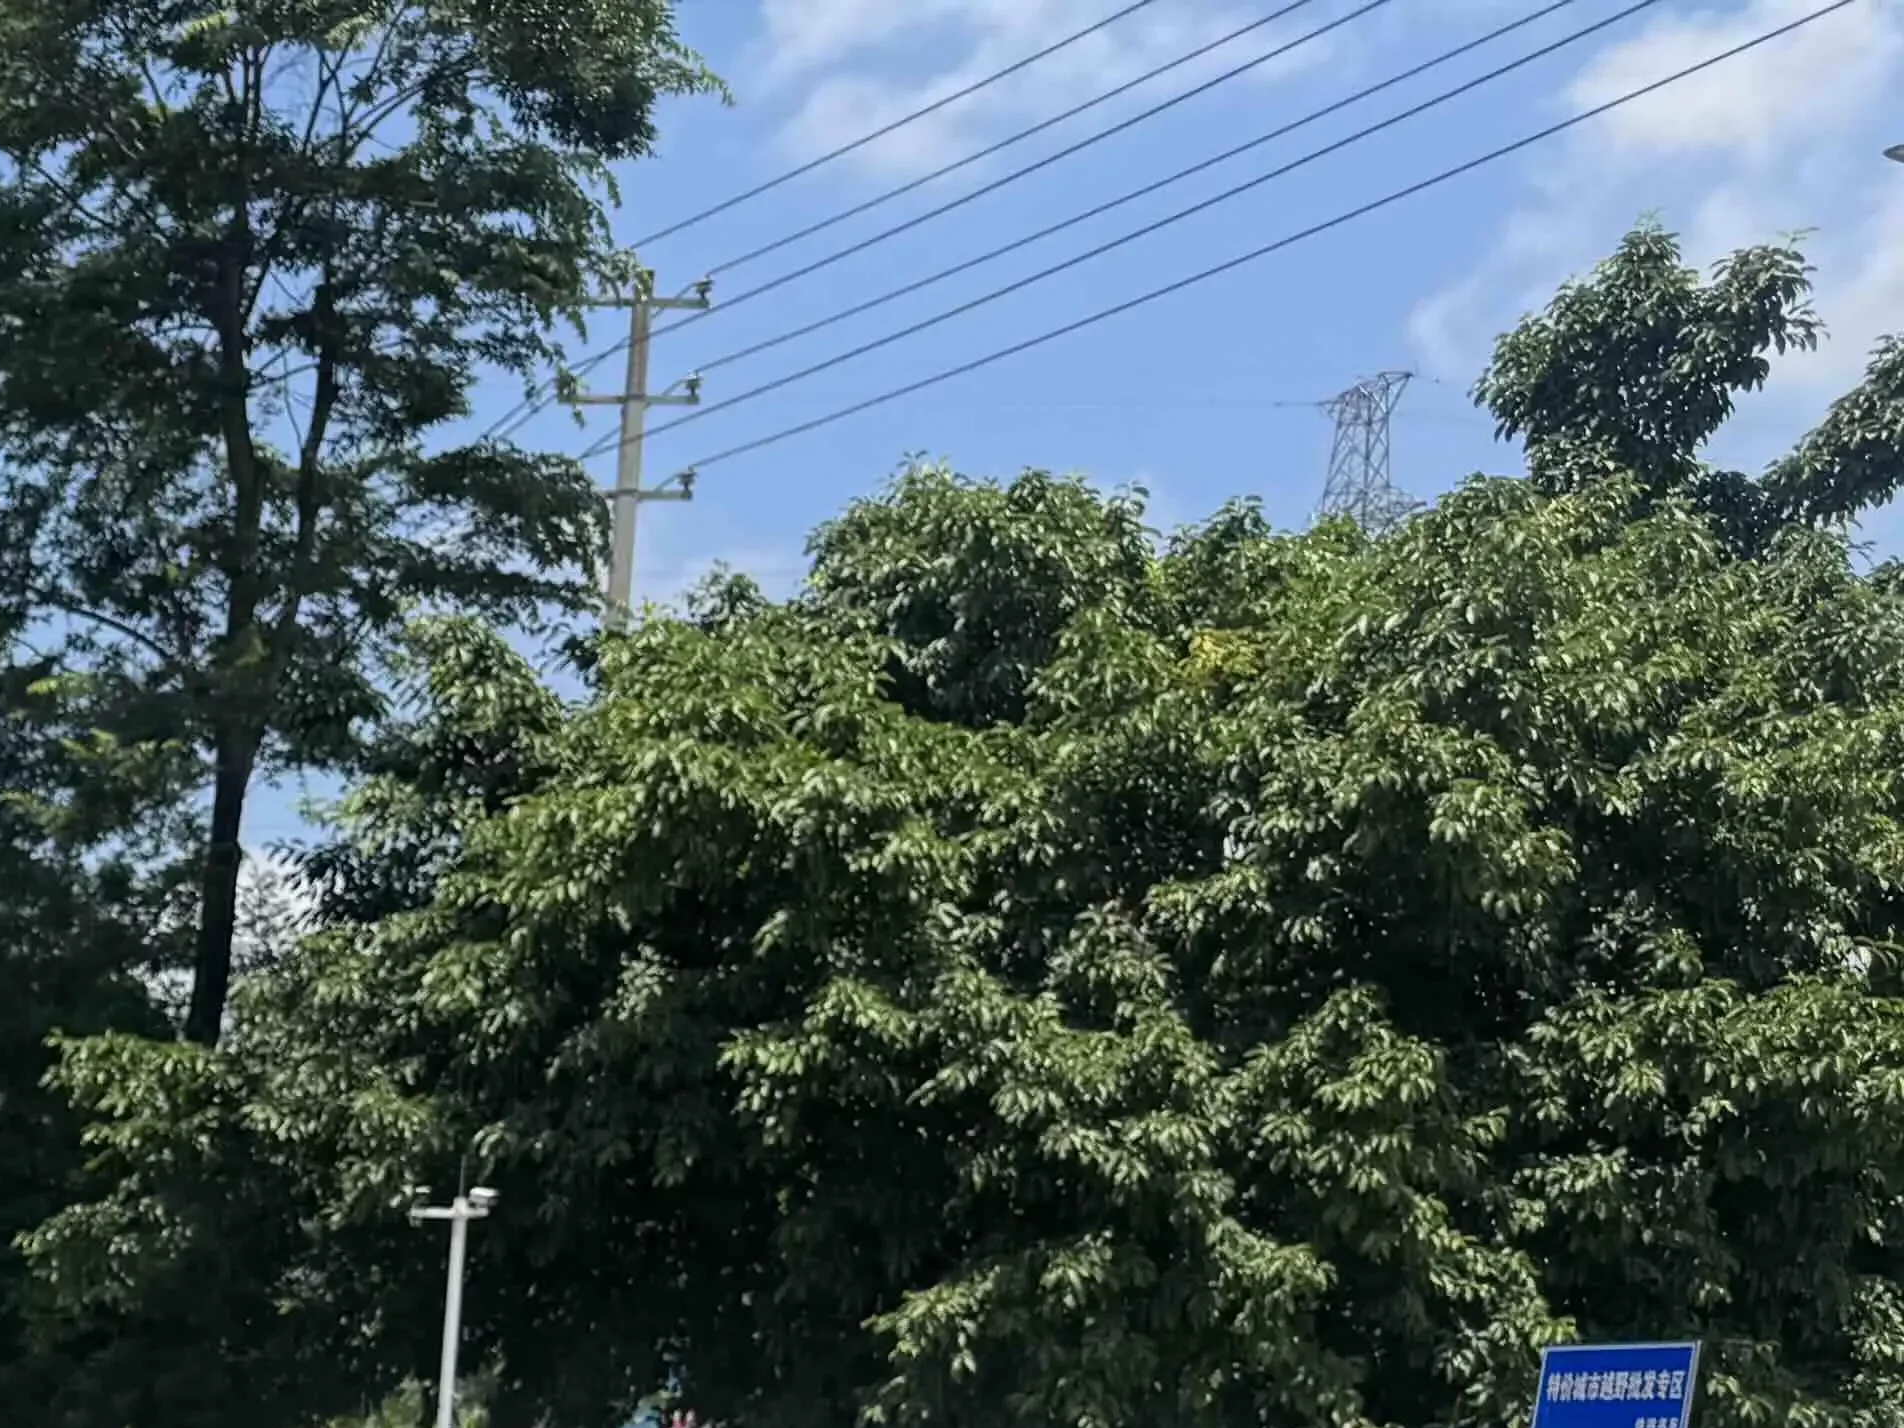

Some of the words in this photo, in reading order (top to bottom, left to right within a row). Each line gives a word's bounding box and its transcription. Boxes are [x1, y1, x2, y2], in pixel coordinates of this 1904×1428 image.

[1546, 1369, 1686, 1403] 特价城市越野批发专区
